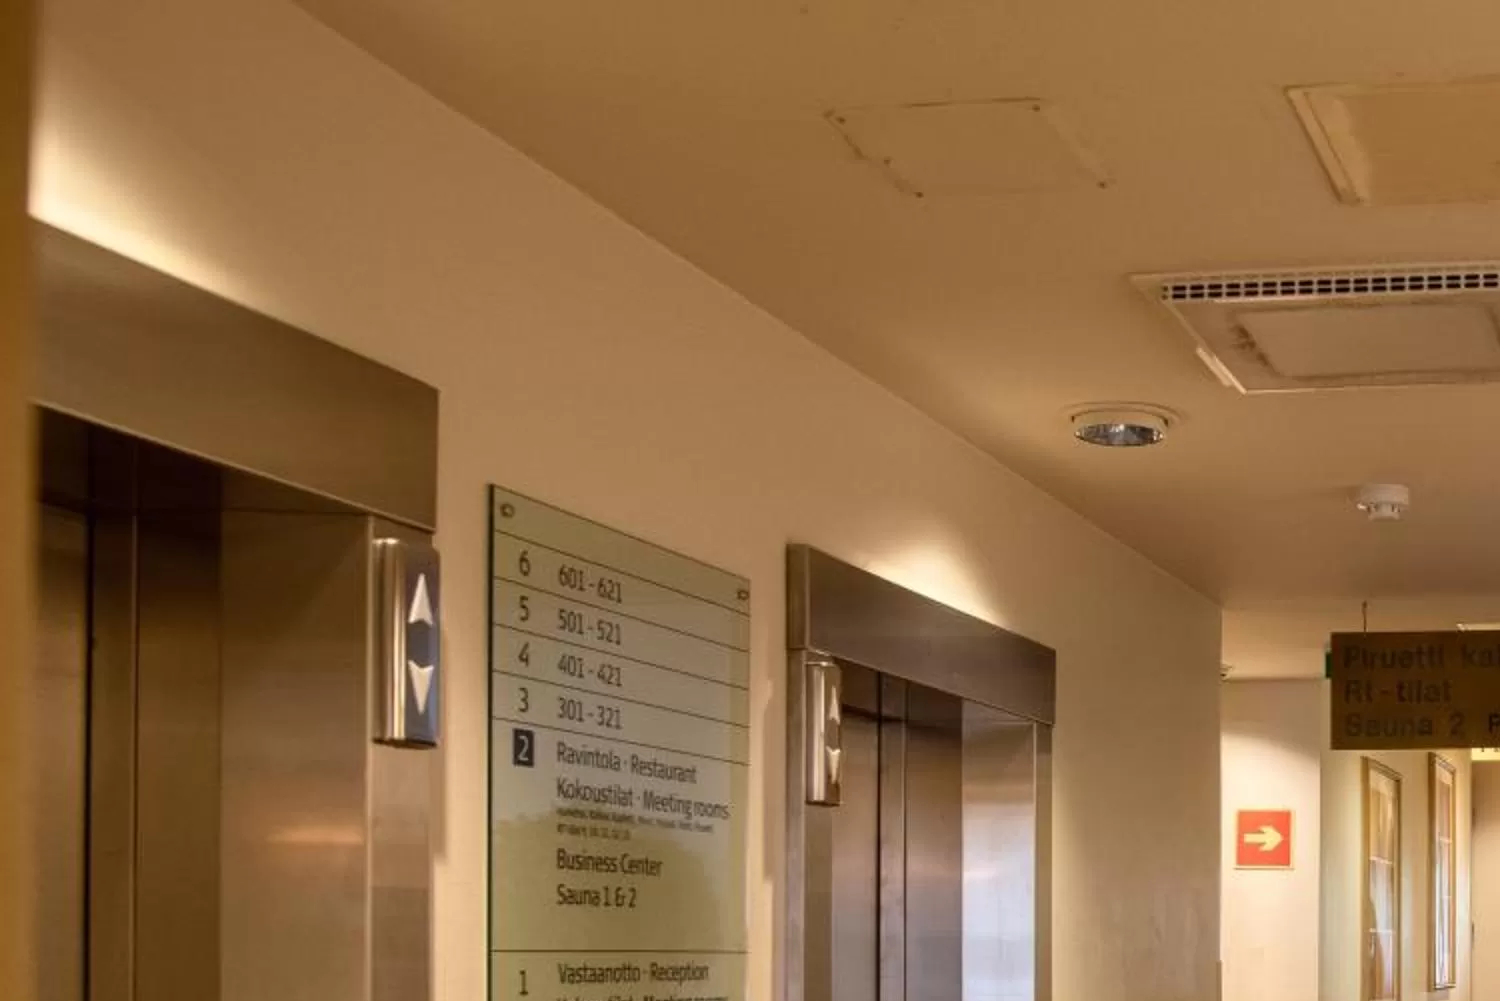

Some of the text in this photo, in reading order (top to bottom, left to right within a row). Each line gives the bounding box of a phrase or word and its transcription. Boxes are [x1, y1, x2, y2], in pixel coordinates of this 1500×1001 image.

[518, 550, 531, 577] 6
[518, 596, 530, 622] 5
[517, 642, 530, 667] 4
[1343, 645, 1444, 670] Piruetti
[518, 687, 530, 713] 3
[1344, 712, 1465, 738] Sauna 2
[518, 735, 530, 762] 2
[556, 741, 621, 772] Ravintola
[631, 753, 698, 784] Restaurant
[556, 777, 633, 808] Kokoustilat
[643, 789, 693, 820] Meeting
[694, 801, 731, 820] rooms
[556, 849, 663, 877] Business Center
[556, 884, 600, 907] Sauna
[603, 886, 611, 908] 1
[628, 888, 637, 909] 2
[518, 969, 529, 996] 1
[557, 962, 641, 985] Vastaanotto
[650, 961, 710, 989] Reception
